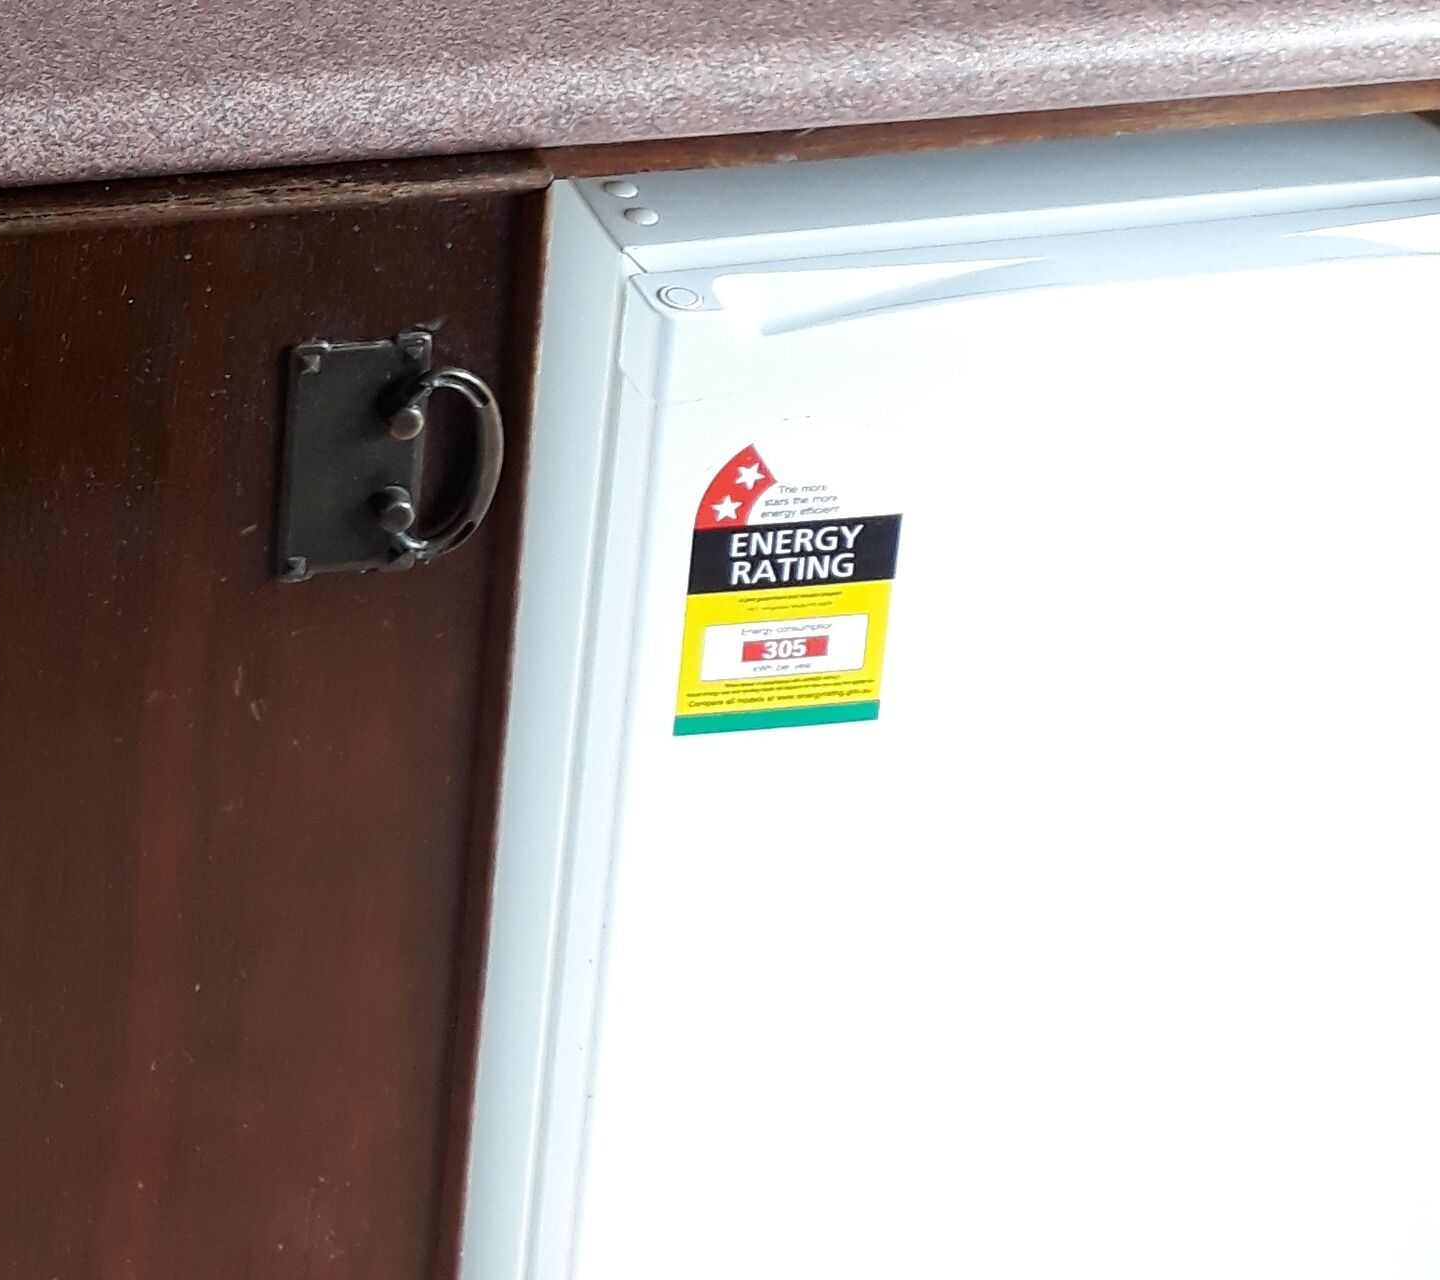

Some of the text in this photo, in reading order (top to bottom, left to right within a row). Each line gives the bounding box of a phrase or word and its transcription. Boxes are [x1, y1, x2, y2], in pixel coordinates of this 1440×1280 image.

[777, 483, 829, 495] The more
[812, 494, 839, 504] more
[760, 508, 798, 519] energy
[729, 523, 865, 558] ENERGY
[730, 552, 855, 586] RATING
[762, 639, 807, 660] 305
